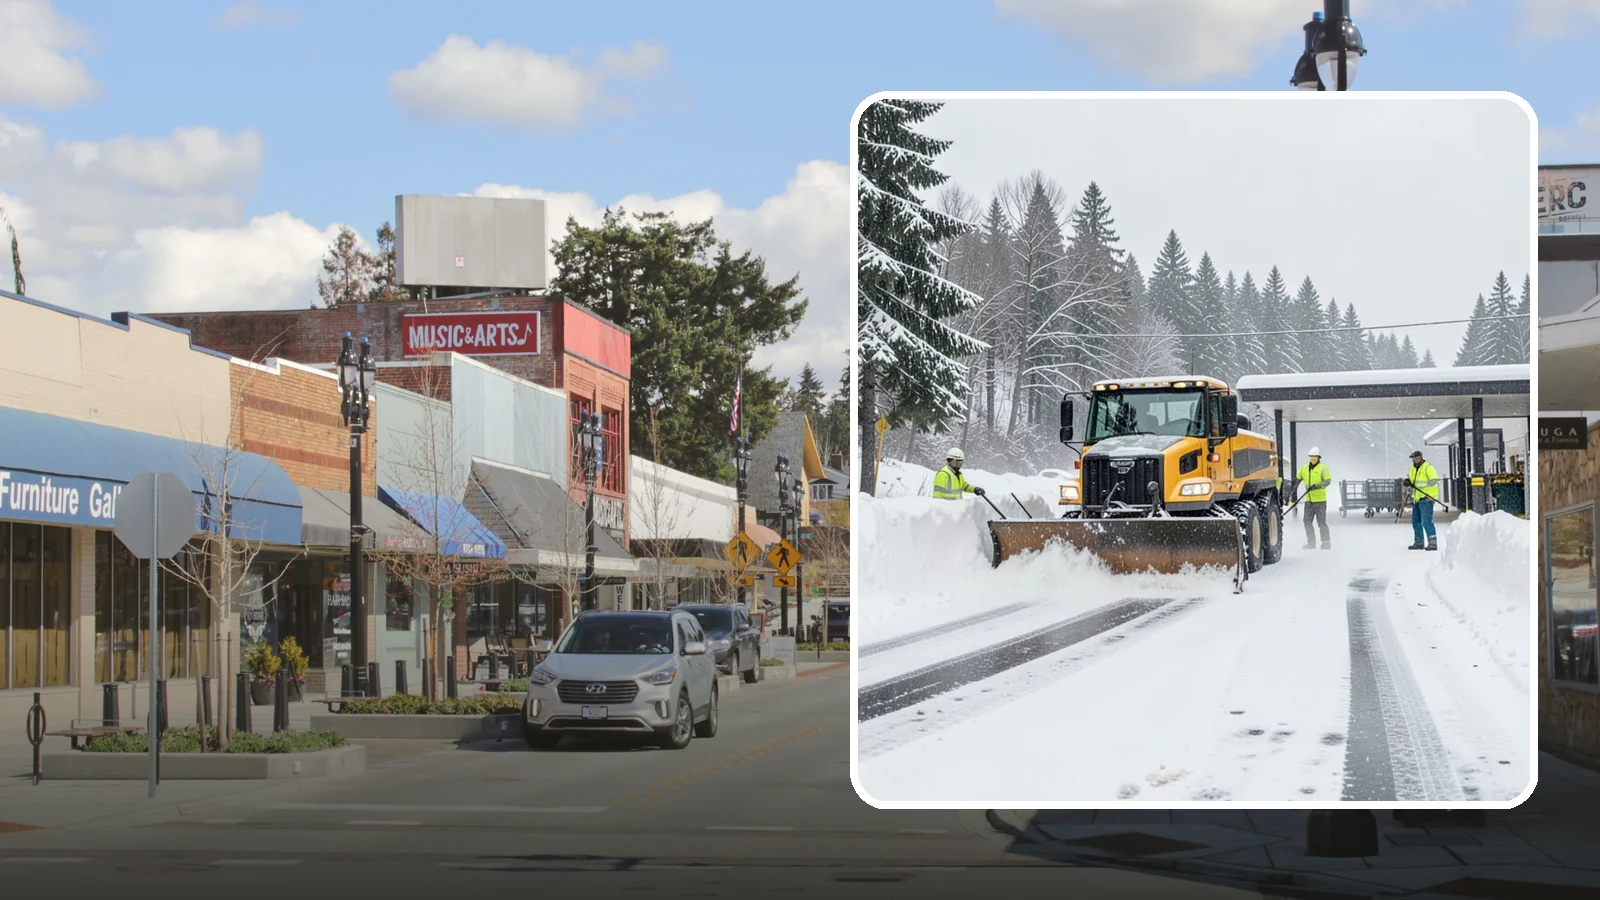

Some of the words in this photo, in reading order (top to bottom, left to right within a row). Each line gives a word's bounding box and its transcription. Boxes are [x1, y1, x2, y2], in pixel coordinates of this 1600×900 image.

[409, 323, 519, 348] MUSIC&ARTS
[0, 471, 79, 515] Furniture
[453, 563, 479, 574] SUSHI
